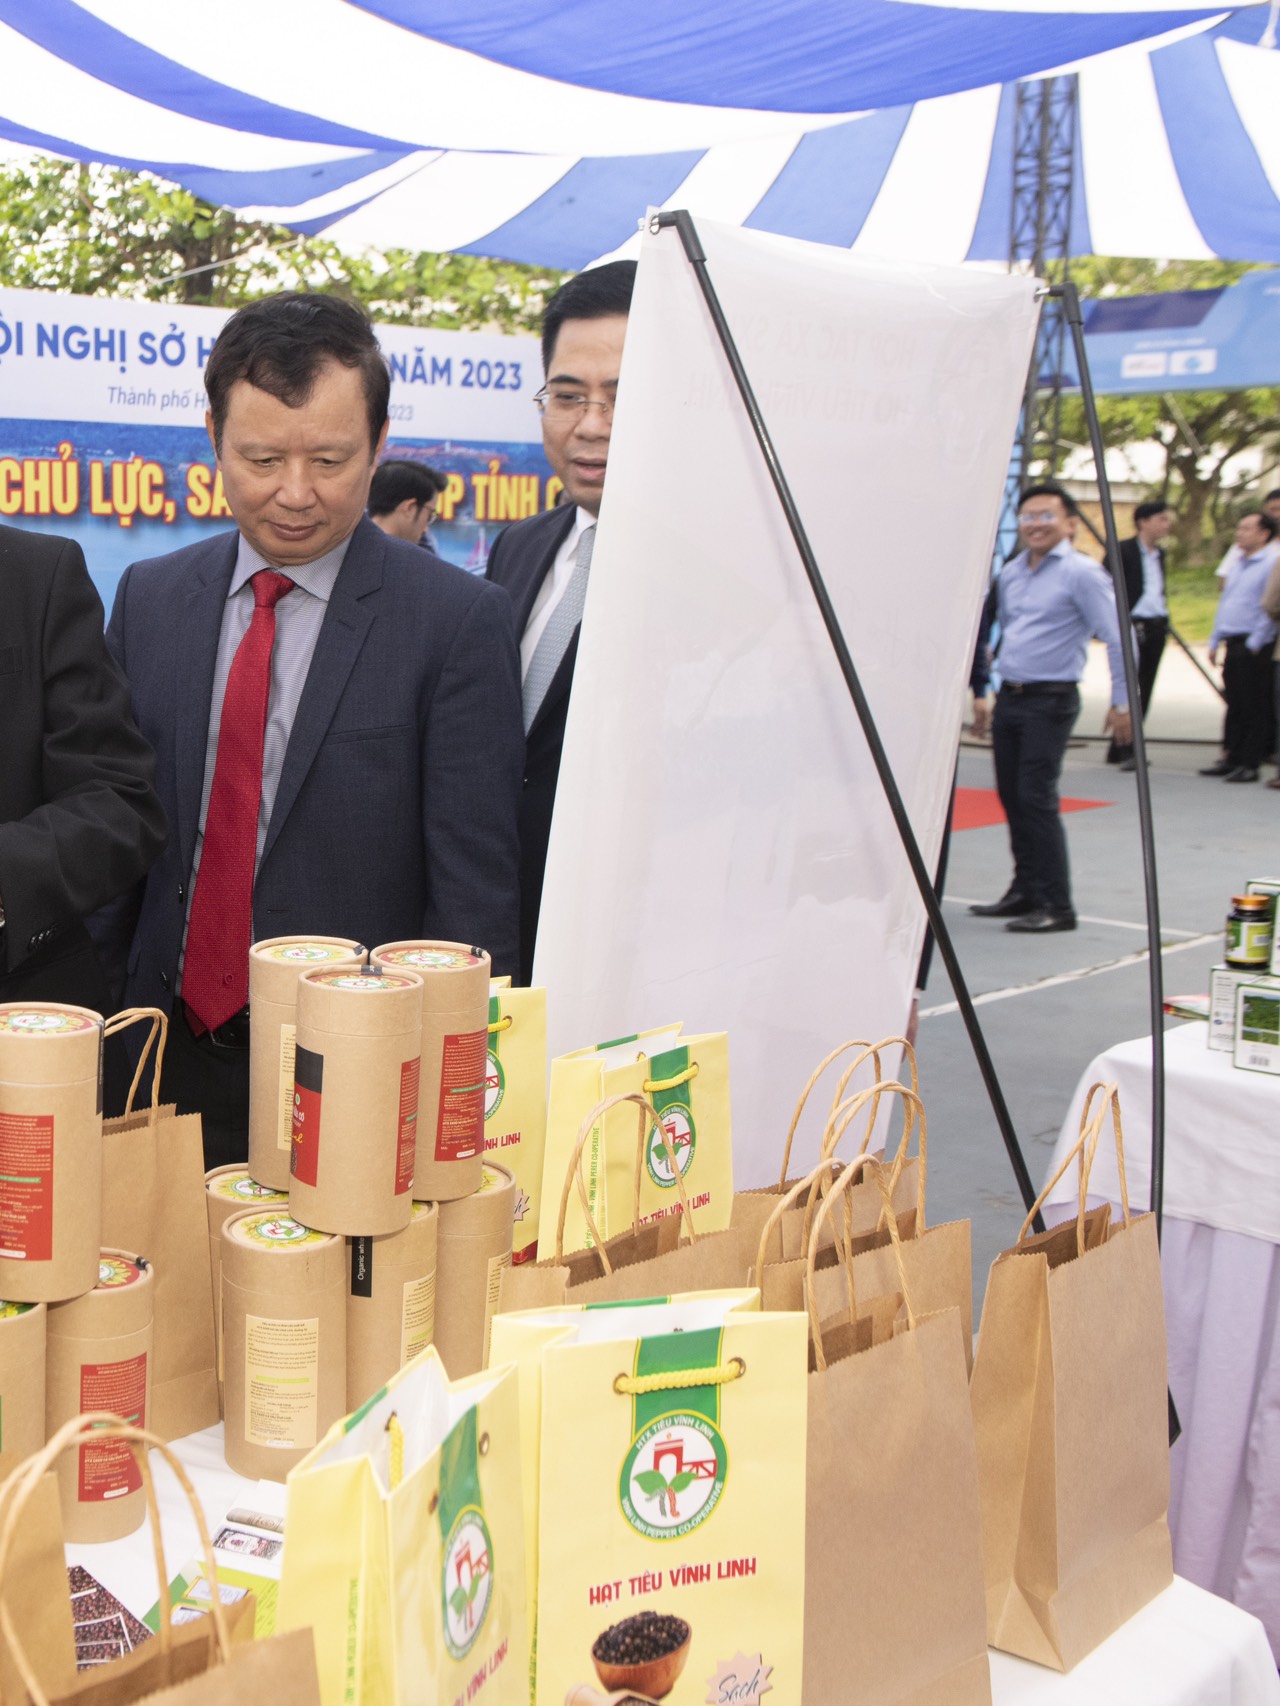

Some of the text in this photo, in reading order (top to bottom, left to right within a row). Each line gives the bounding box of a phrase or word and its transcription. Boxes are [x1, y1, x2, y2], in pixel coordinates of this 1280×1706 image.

[37, 323, 127, 374] NGHỊ
[138, 322, 186, 368] SỞ
[390, 346, 522, 391] NĂM 2023
[108, 386, 156, 406] Thành
[160, 389, 190, 411] phố
[89, 455, 176, 528] LỰC,
[471, 459, 540, 521] TỈNH
[483, 1088, 504, 1121] O-OPERATIVE
[501, 1132, 521, 1146] LINH
[692, 1192, 710, 1210] LINH
[357, 1254, 366, 1280] Organic
[635, 1415, 715, 1450] HTX TIÊU VĨNH LINH
[645, 1527, 678, 1539] PEPPER
[678, 1481, 724, 1536] CO-OPERATIVE
[589, 1557, 757, 1608] HẠT TIÊU VĨNH LINH
